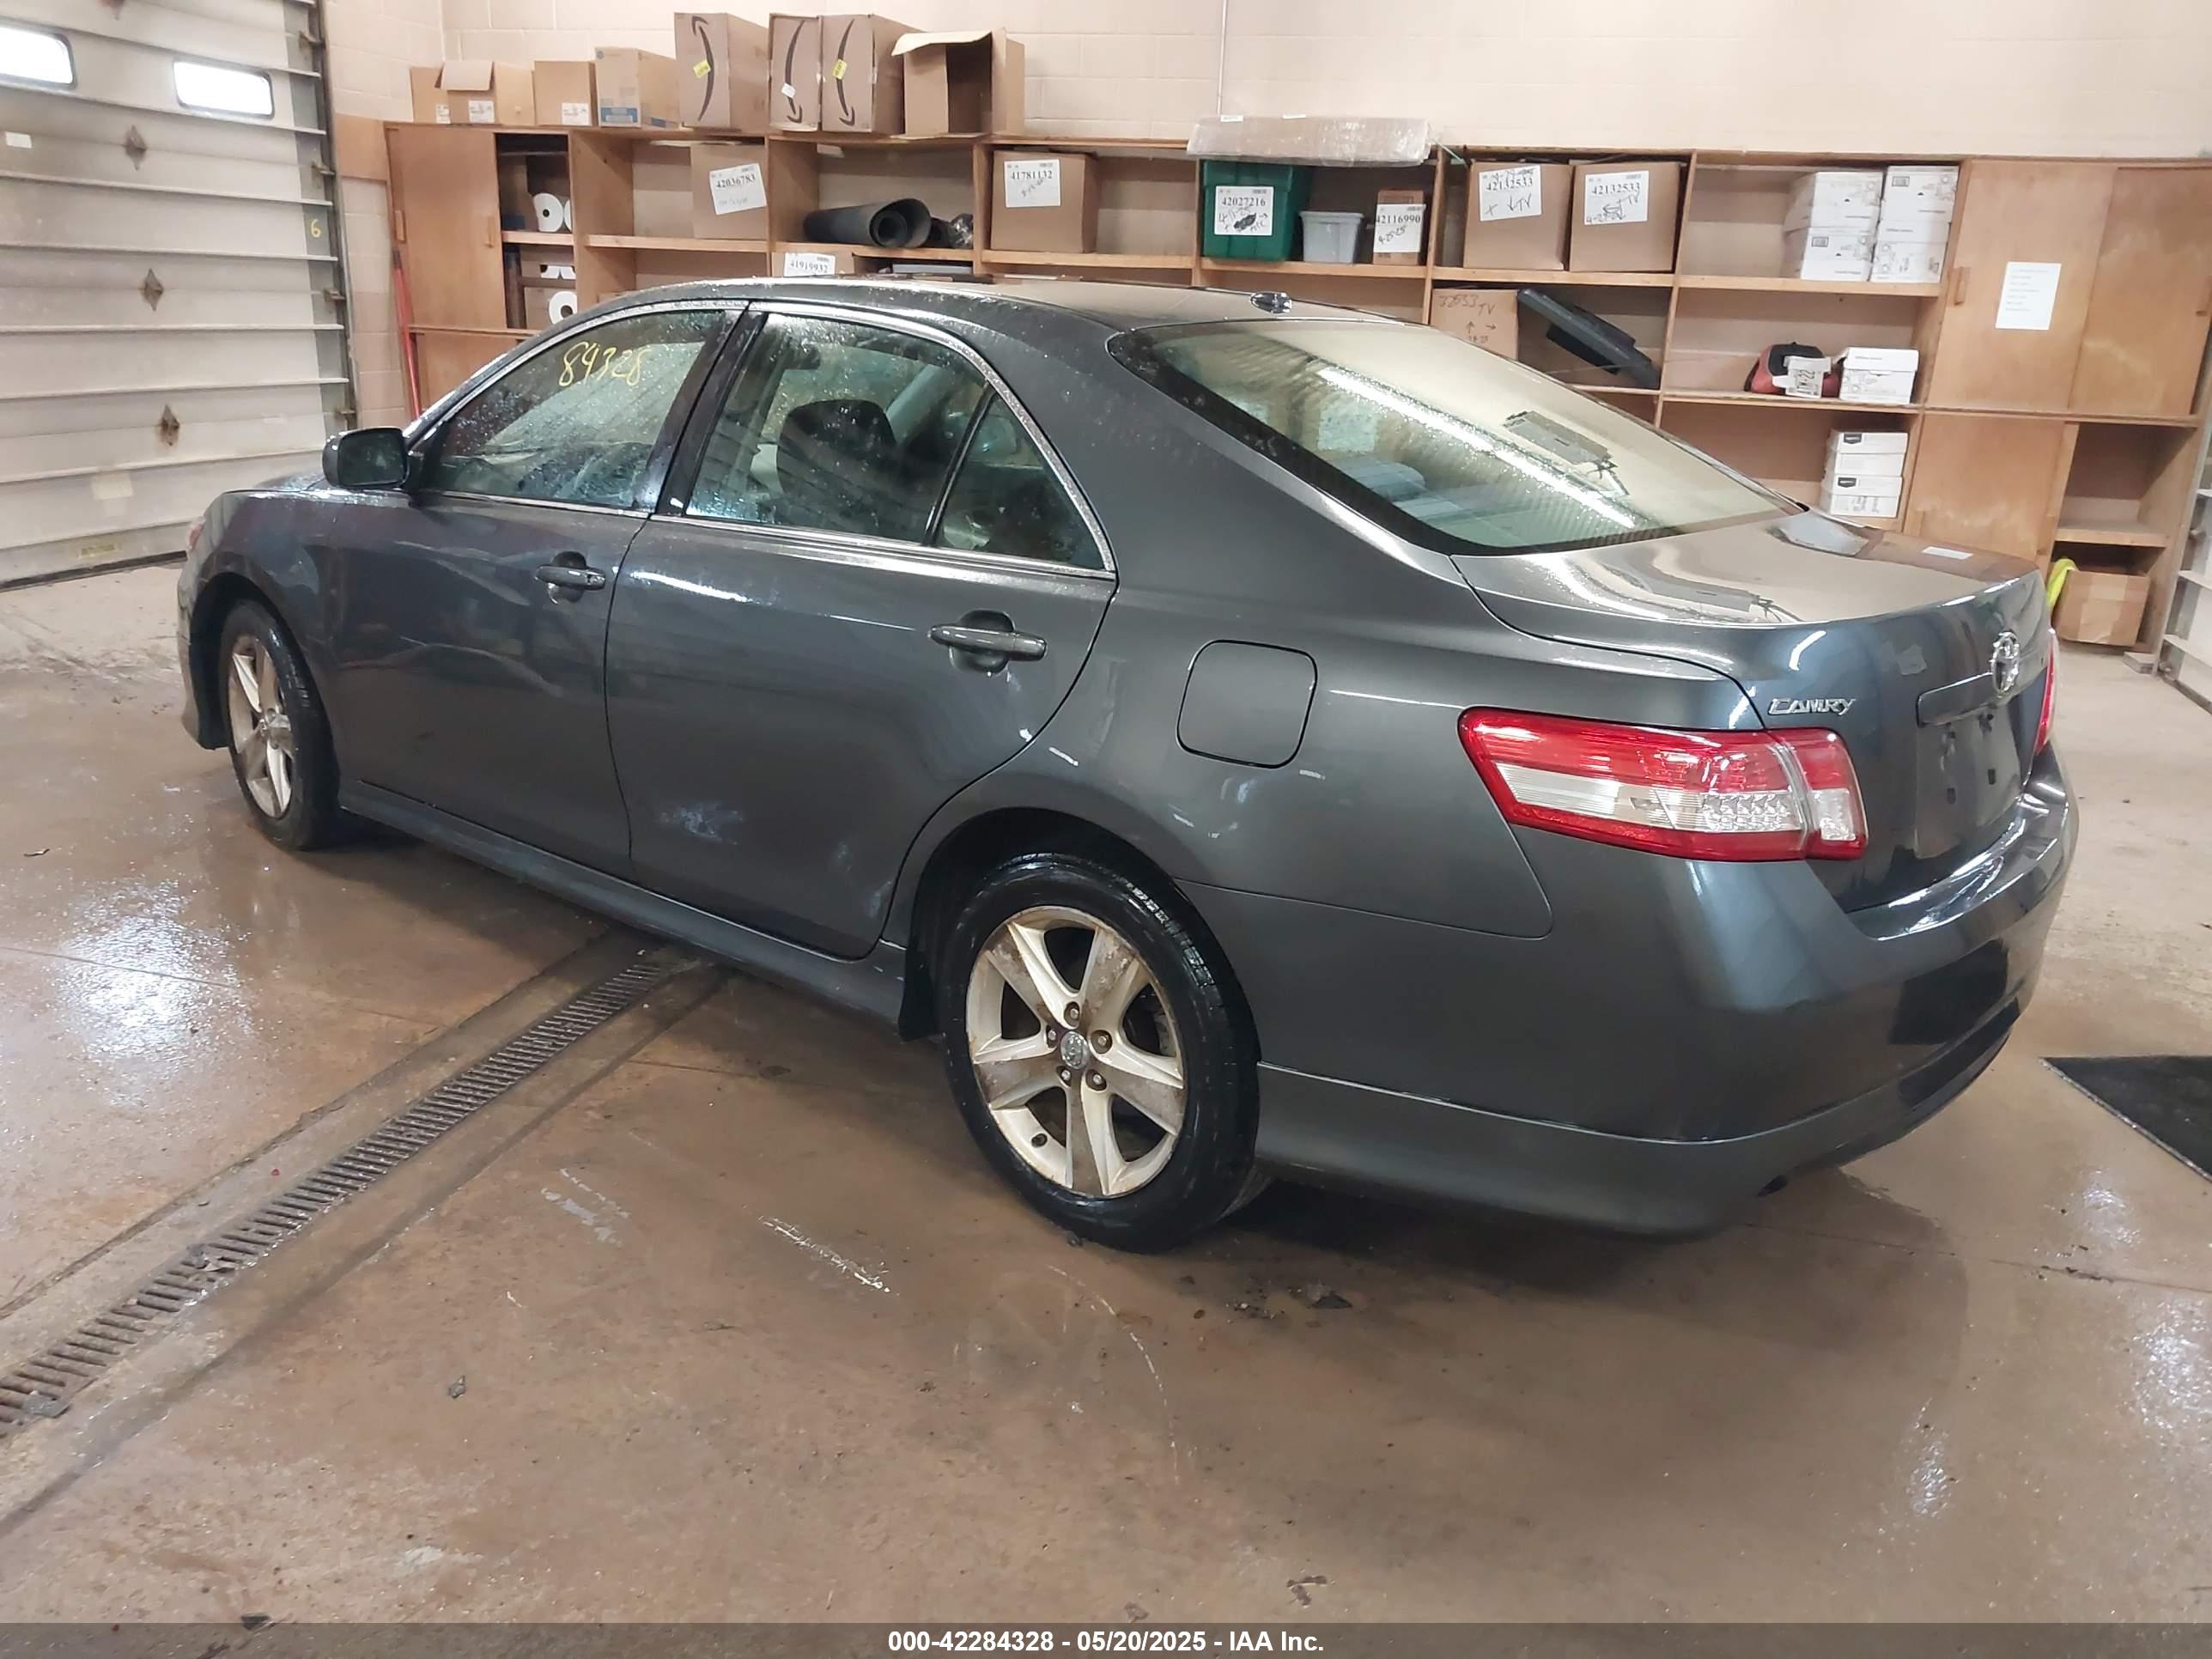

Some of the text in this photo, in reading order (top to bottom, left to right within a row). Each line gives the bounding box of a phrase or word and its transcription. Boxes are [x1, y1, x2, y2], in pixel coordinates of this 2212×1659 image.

[1011, 170, 1053, 179] 41781132
[1486, 177, 1534, 191] 42132533
[1591, 182, 1640, 195] 42132533
[1222, 197, 1267, 207] 42027216
[1376, 215, 1421, 224] 42116990
[311, 218, 321, 238] 6
[1479, 302, 1496, 316] TV
[1768, 697, 1856, 716] CAMRY
